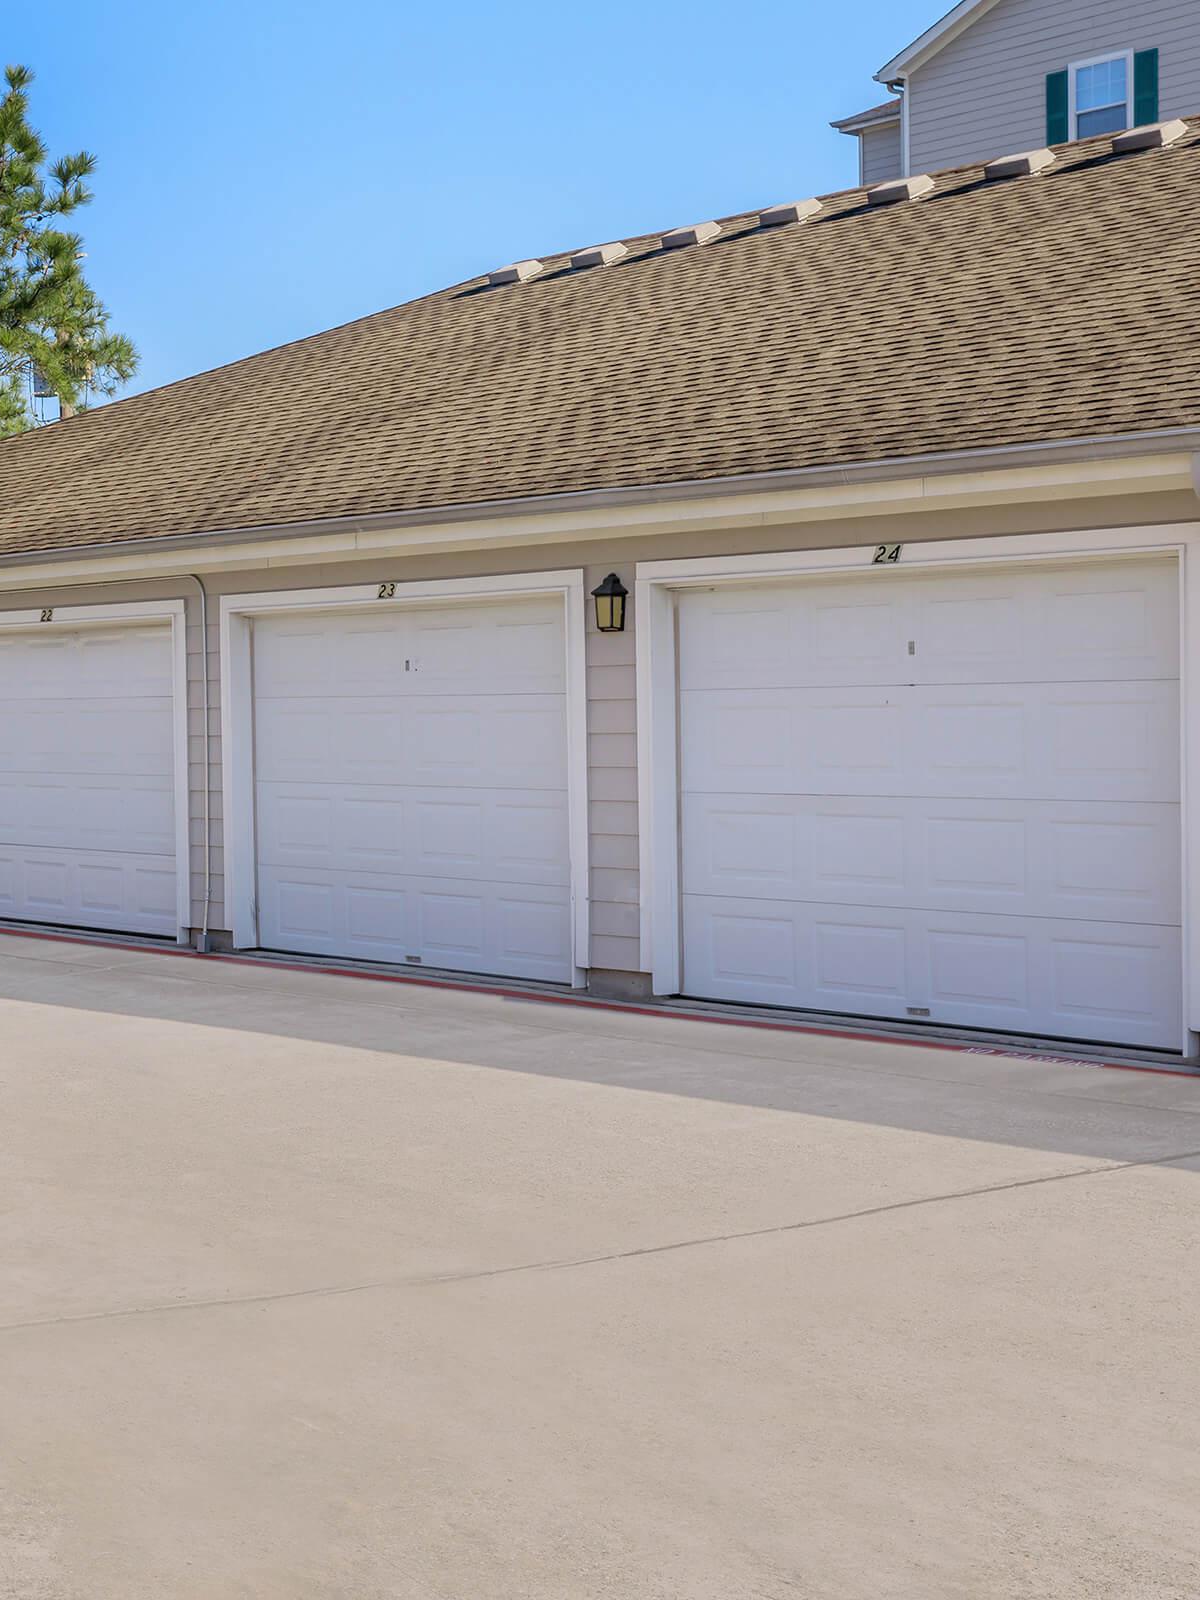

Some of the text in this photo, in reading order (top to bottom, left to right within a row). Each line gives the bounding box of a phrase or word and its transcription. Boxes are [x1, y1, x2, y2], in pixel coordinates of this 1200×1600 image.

[874, 545, 901, 563] 24
[378, 583, 395, 598] 23
[40, 609, 53, 622] 22
[960, 1047, 1105, 1068] NO PARKING
